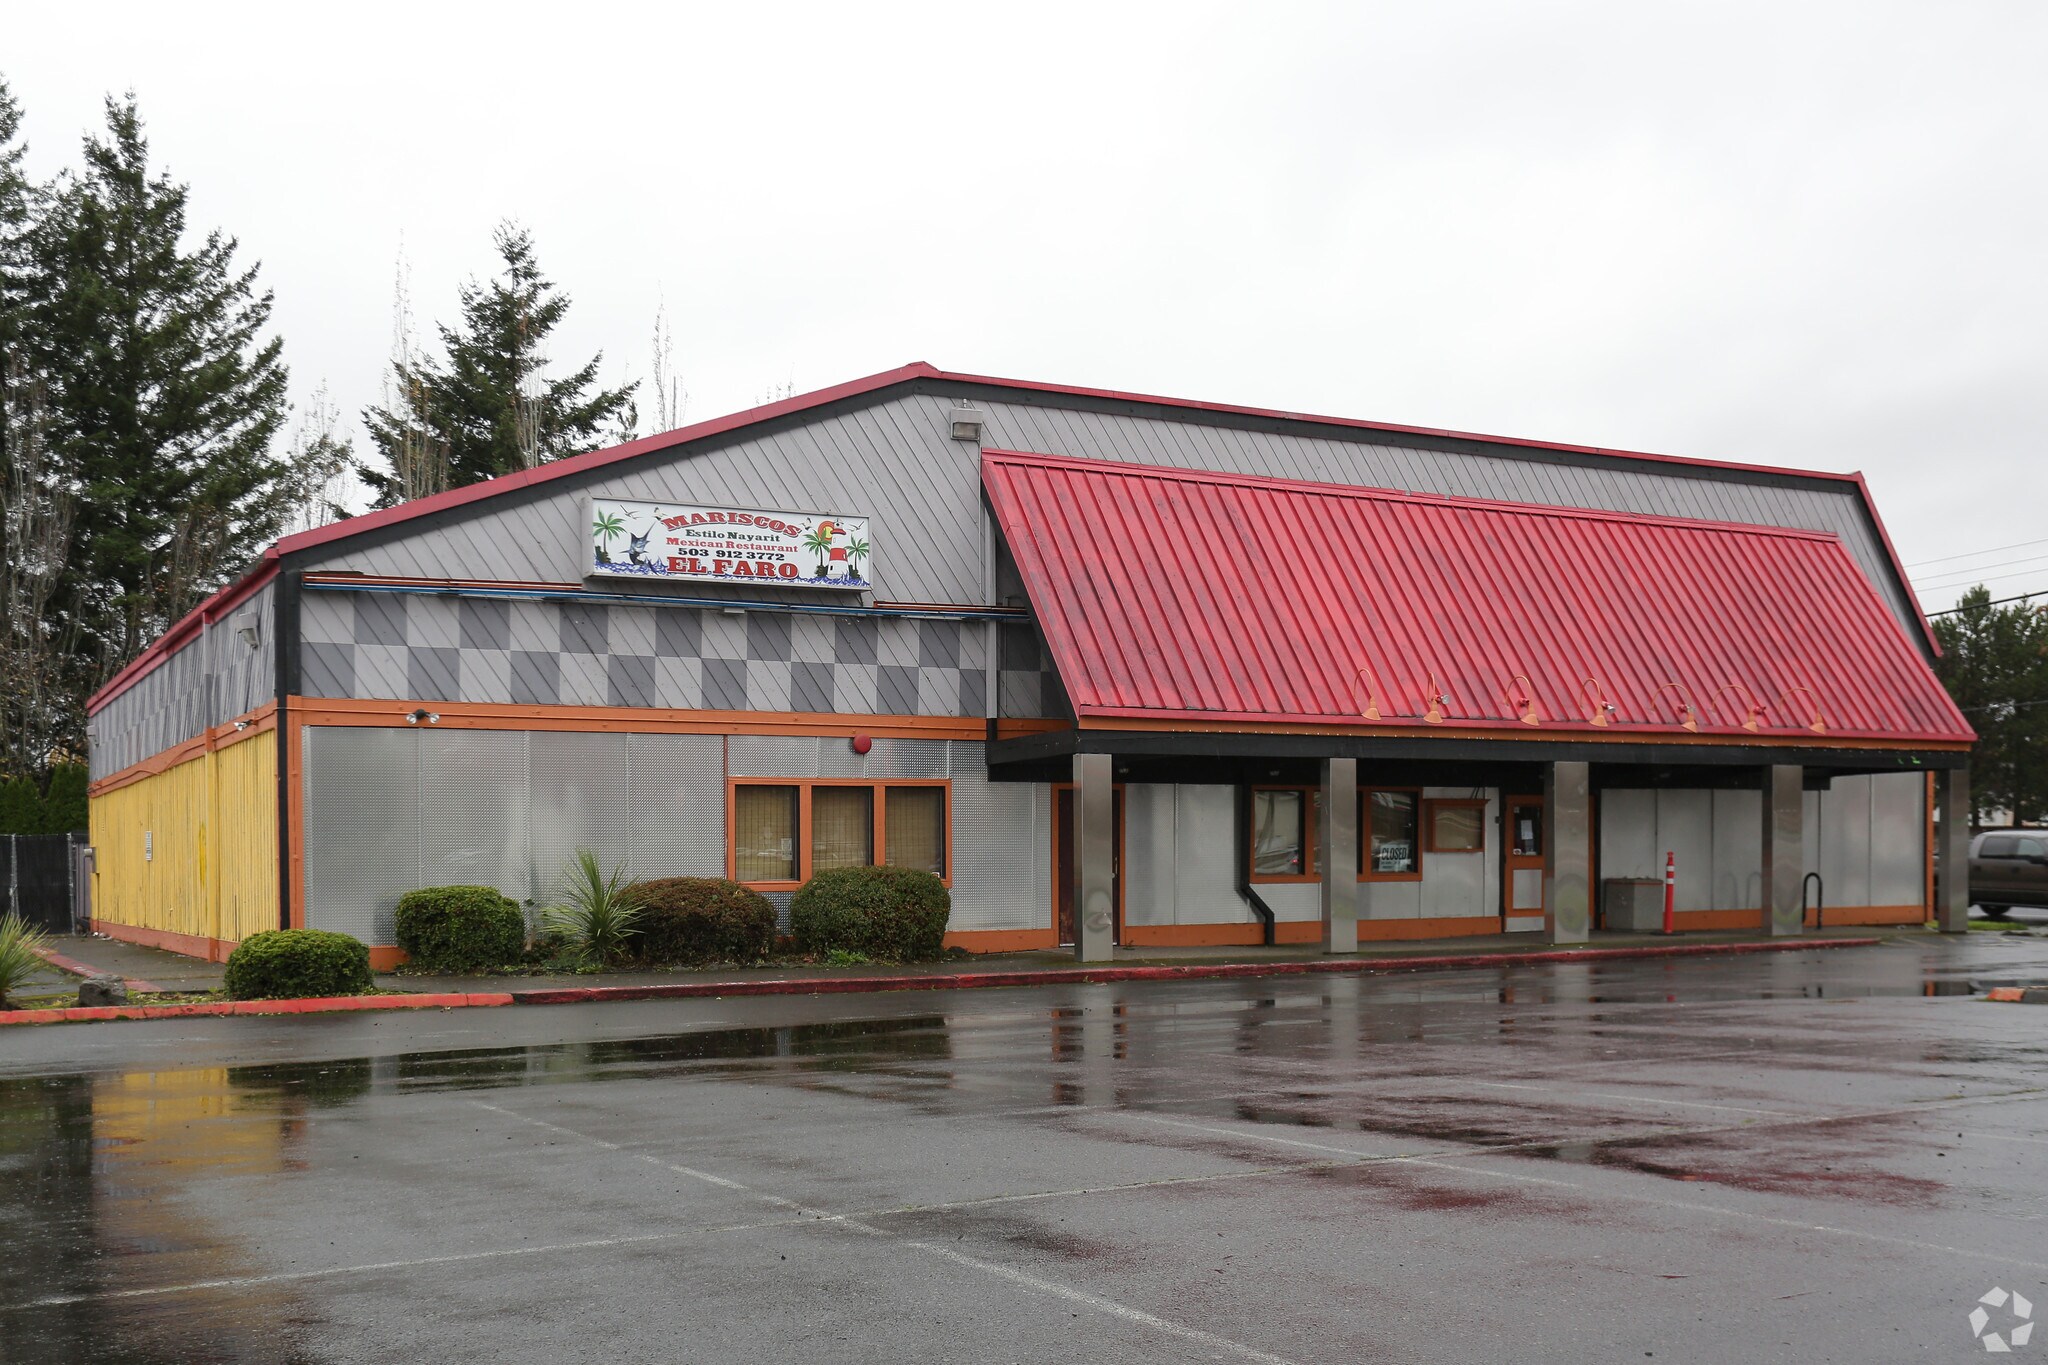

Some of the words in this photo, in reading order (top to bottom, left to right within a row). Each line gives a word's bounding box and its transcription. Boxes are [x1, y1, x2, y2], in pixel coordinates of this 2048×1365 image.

[661, 512, 802, 537] MARISCOS
[685, 529, 725, 539] Estilo
[727, 531, 780, 542] Nayarit
[666, 537, 725, 548] Mexican
[725, 541, 798, 552] Restaurant
[678, 548, 709, 557] 503
[716, 550, 742, 559] 912
[746, 552, 785, 561] 3772
[667, 556, 708, 575] EL
[712, 559, 799, 579] FARO
[1382, 848, 1407, 860] CLOSED
